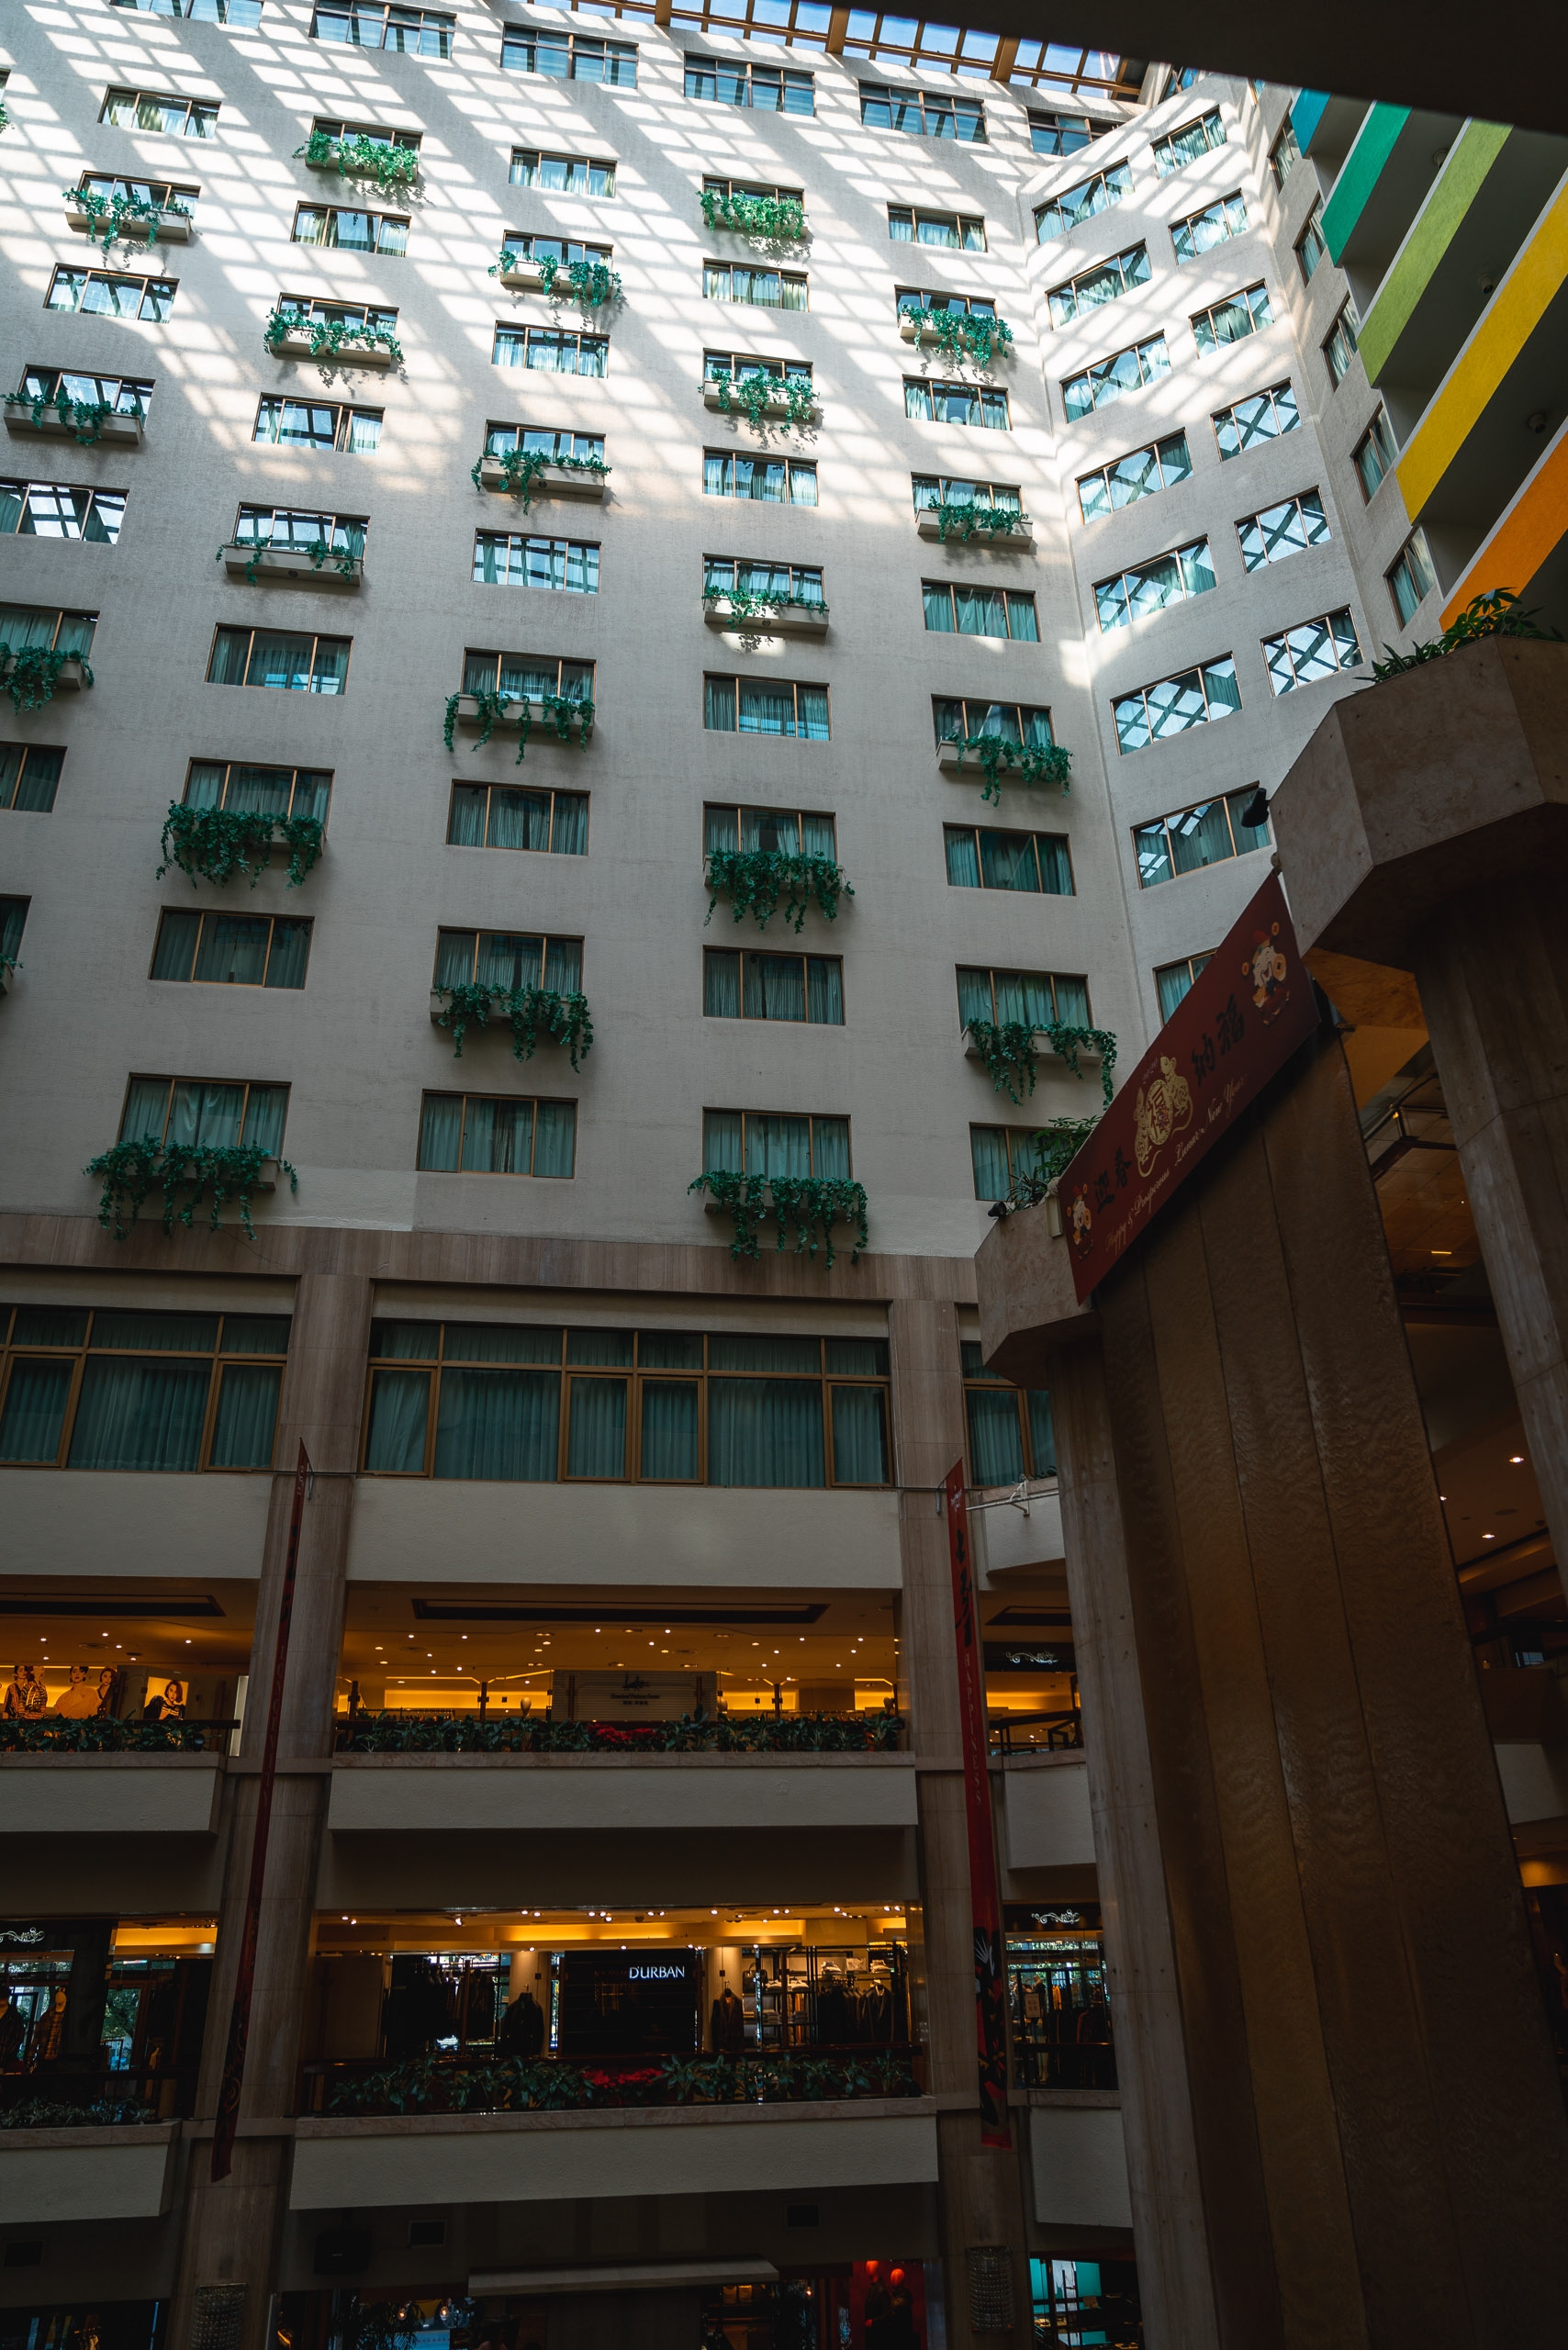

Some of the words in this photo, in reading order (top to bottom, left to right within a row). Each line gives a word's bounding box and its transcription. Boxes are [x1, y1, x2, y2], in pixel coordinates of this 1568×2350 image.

[1093, 1146, 1131, 1215] 迎春
[1133, 1166, 1170, 1214] Prosperous
[1174, 1129, 1204, 1166] Lunar
[1204, 1098, 1222, 1128] New
[1223, 1076, 1247, 1117] Year
[964, 1653, 981, 1806] HAPPINESS
[629, 1965, 685, 1979] D'URBAN
